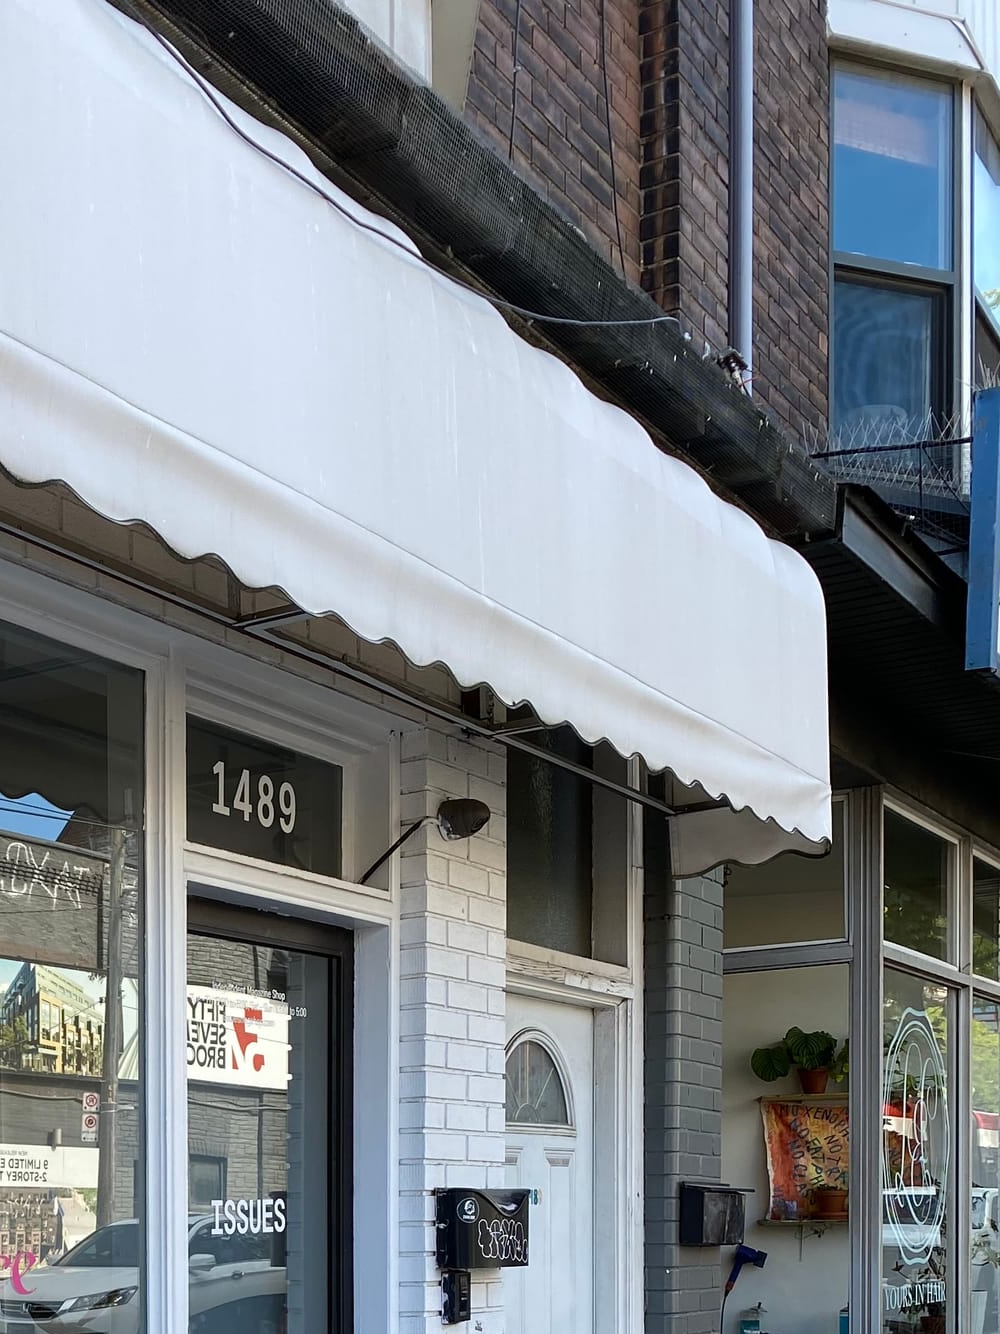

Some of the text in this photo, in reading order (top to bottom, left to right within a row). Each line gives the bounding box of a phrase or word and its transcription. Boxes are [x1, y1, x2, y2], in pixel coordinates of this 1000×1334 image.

[211, 760, 296, 834] 1489
[272, 988, 286, 1001] Shop
[804, 1108, 849, 1139] XENOPH
[824, 1133, 843, 1154] NO
[210, 1197, 286, 1235] ISSUES
[884, 1280, 947, 1311] YOURS IN HAIR
